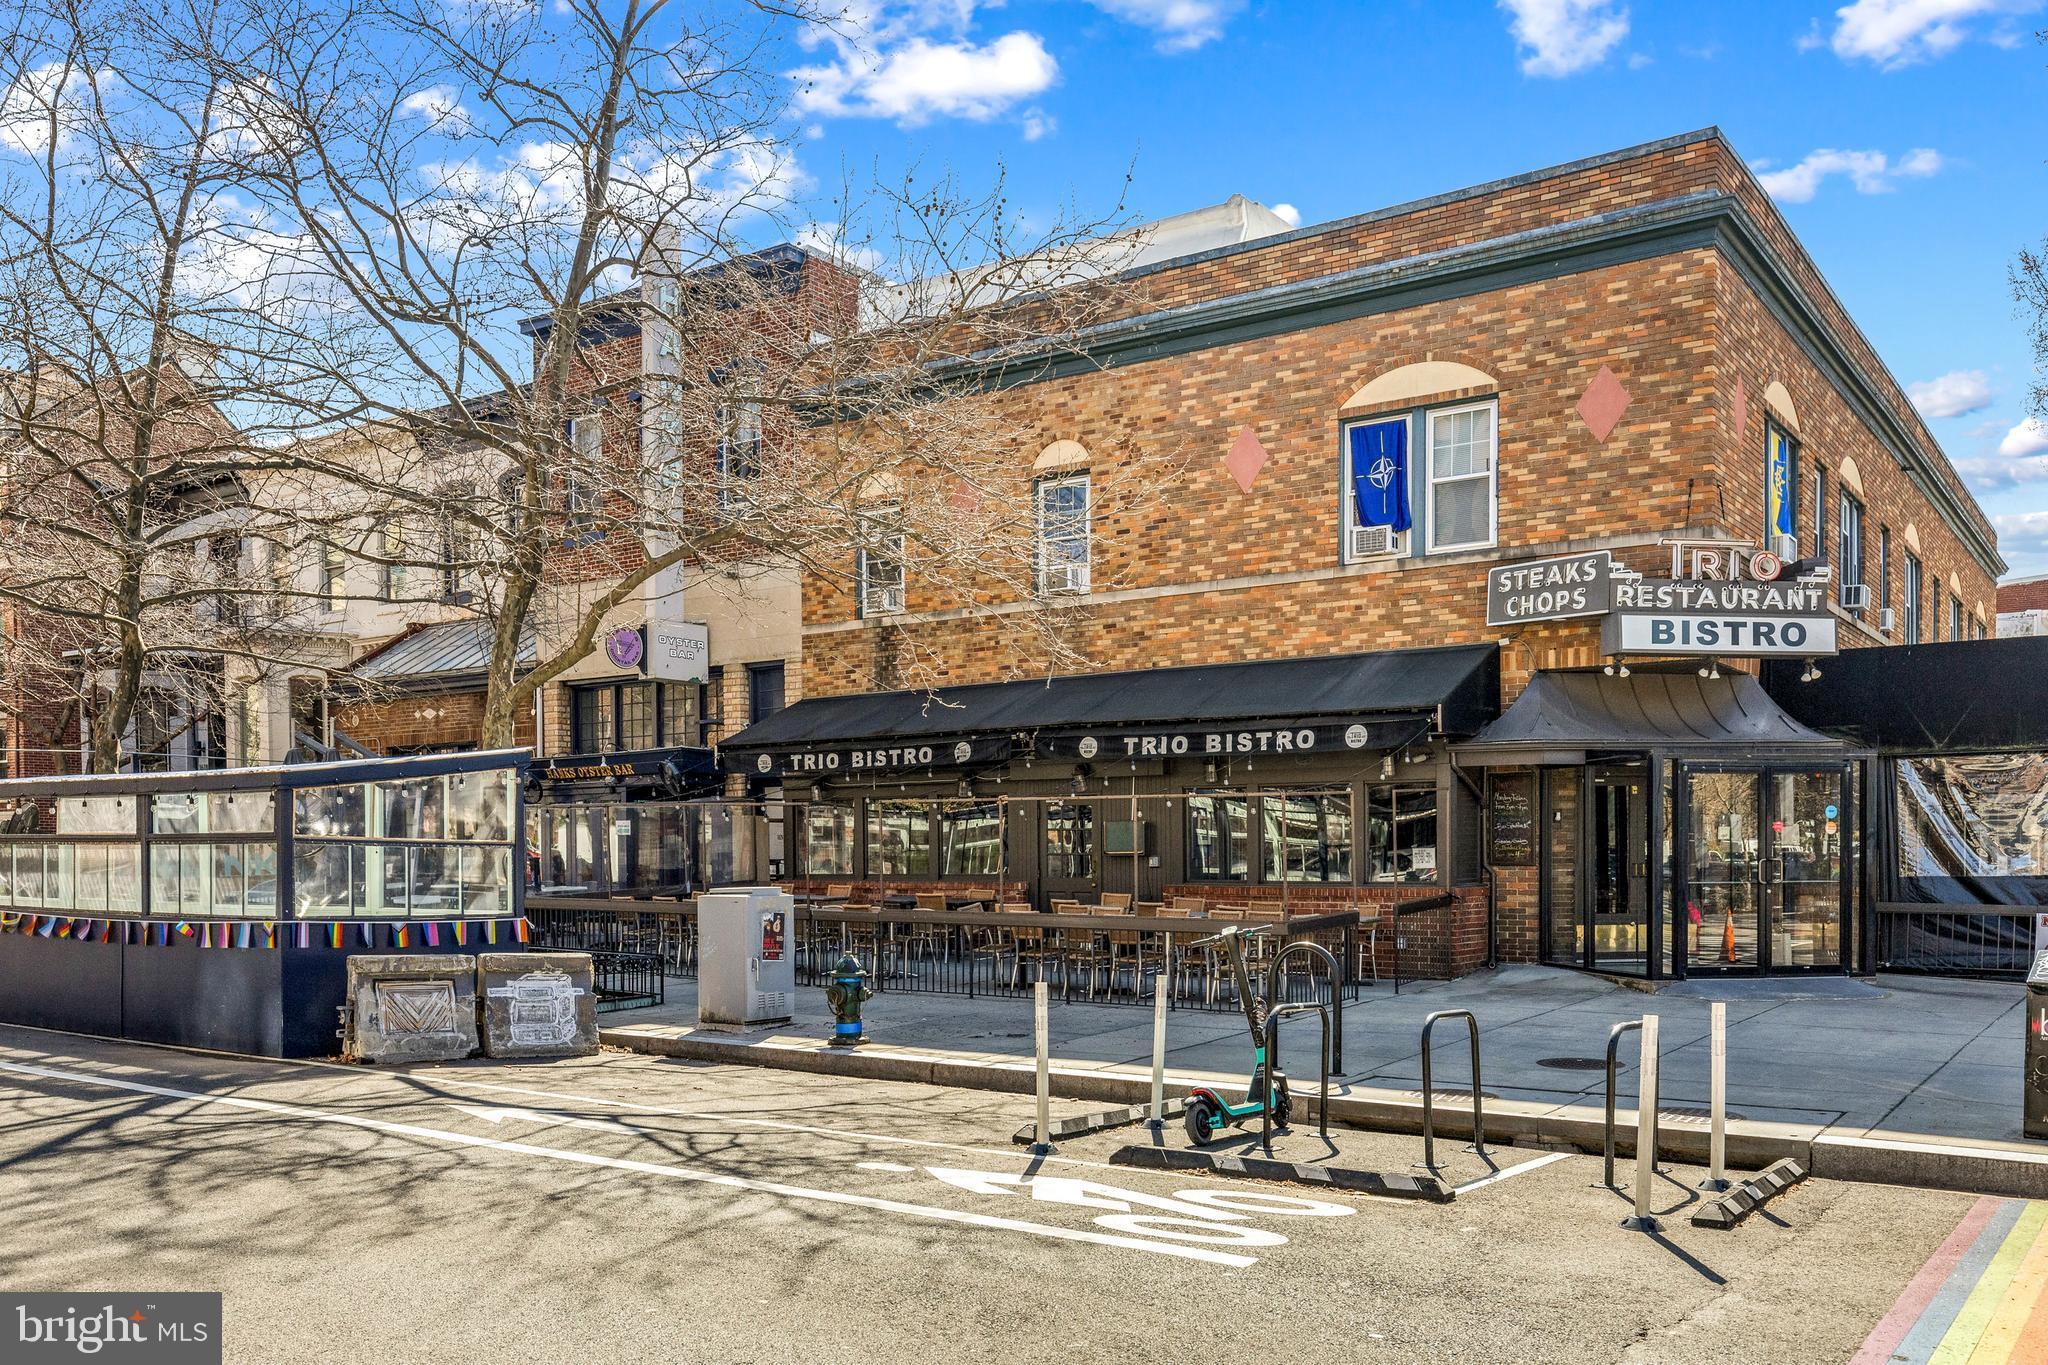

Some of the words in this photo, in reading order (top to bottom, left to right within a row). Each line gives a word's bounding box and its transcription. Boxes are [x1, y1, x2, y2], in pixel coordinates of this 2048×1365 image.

[1657, 537, 1782, 582] TRIO
[1498, 558, 1597, 593] STEAKS
[1506, 587, 1587, 617] CHOPS
[1617, 584, 1823, 611] RESTAURANT
[658, 635, 705, 650] OYSTER
[1651, 619, 1808, 648] BISTRO
[669, 648, 694, 660] BAR
[1124, 735, 1189, 756] TRIO
[1205, 729, 1315, 753] BISTRO
[544, 767, 577, 780] HANKS
[578, 765, 614, 778] OYSTER
[615, 763, 635, 776] BAR
[790, 753, 839, 771] TRIO
[852, 747, 933, 768] BISTRO
